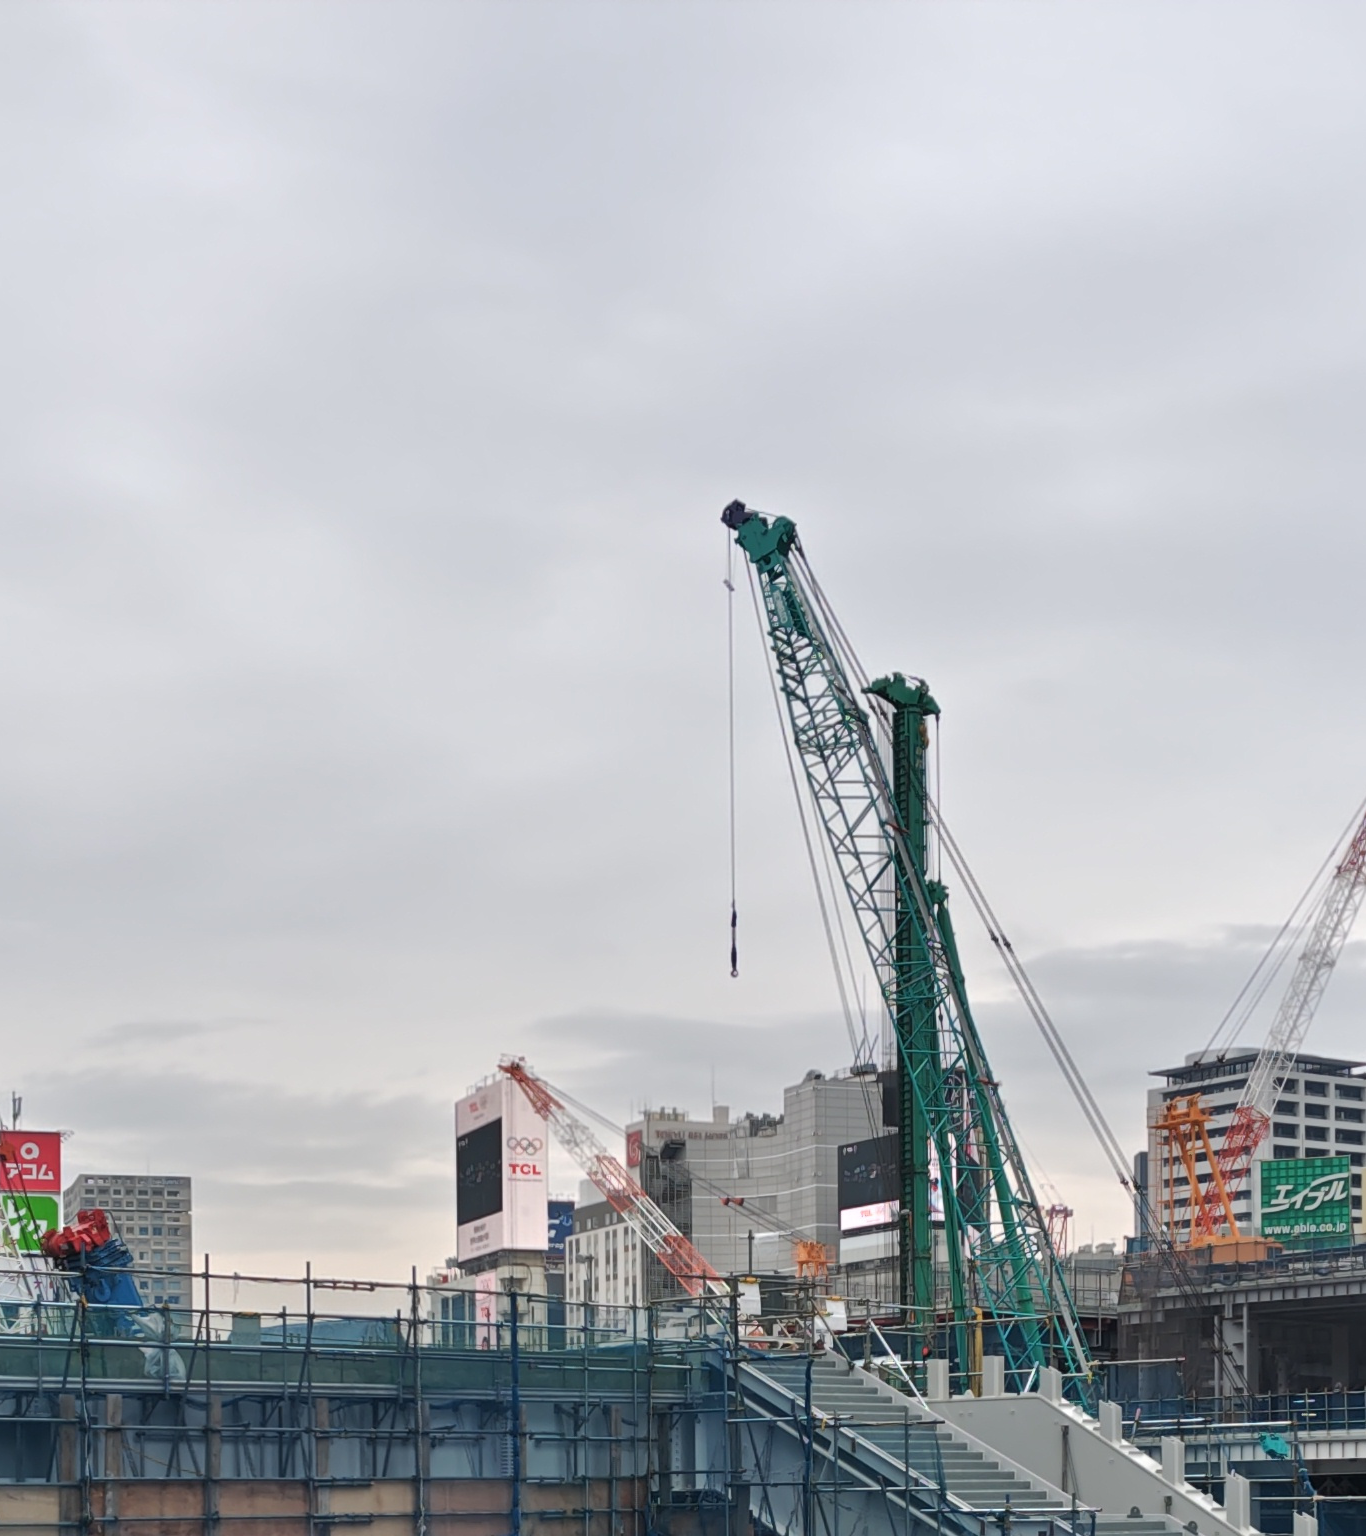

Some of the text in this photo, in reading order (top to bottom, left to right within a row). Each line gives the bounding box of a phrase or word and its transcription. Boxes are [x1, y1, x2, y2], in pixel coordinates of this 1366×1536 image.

[5, 1163, 54, 1180] アコム
[509, 1163, 541, 1176] TCL
[1261, 1172, 1349, 1213] エイブル
